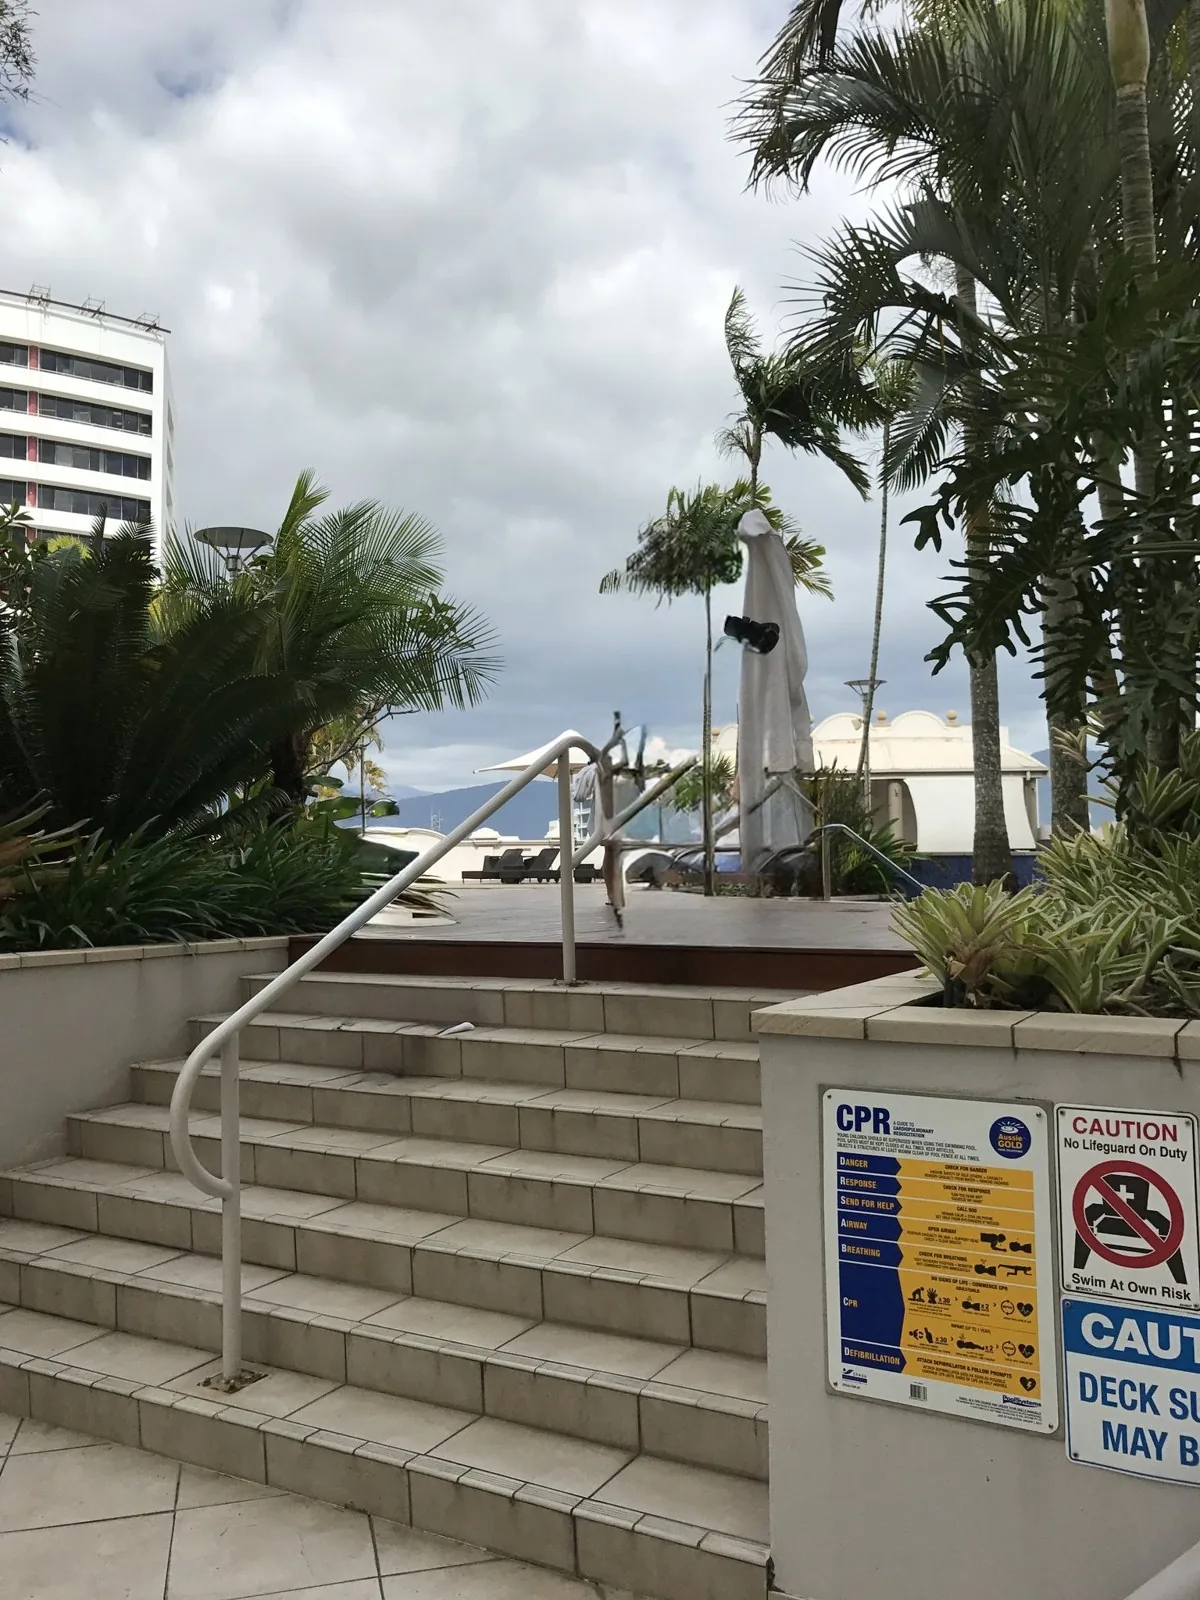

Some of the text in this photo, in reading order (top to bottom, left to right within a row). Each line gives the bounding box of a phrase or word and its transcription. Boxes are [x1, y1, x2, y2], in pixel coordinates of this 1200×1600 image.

[836, 1104, 890, 1134] CPR
[1072, 1116, 1177, 1142] CAUTION
[998, 1140, 1022, 1149] GOLD
[1064, 1138, 1187, 1162] No Lifeguard On Duty
[840, 1157, 868, 1168] DANGER
[840, 1176, 876, 1188] RESPONSE
[840, 1196, 895, 1210] SEND FOR HELP
[840, 1219, 868, 1230] AIRWAY
[842, 1244, 880, 1257] BREATHING
[1072, 1273, 1191, 1301] Swim At Own Risk
[844, 1347, 900, 1365] DEFIBRILLATION
[1079, 1371, 1160, 1416] DECK
[1102, 1420, 1168, 1461] MAY
